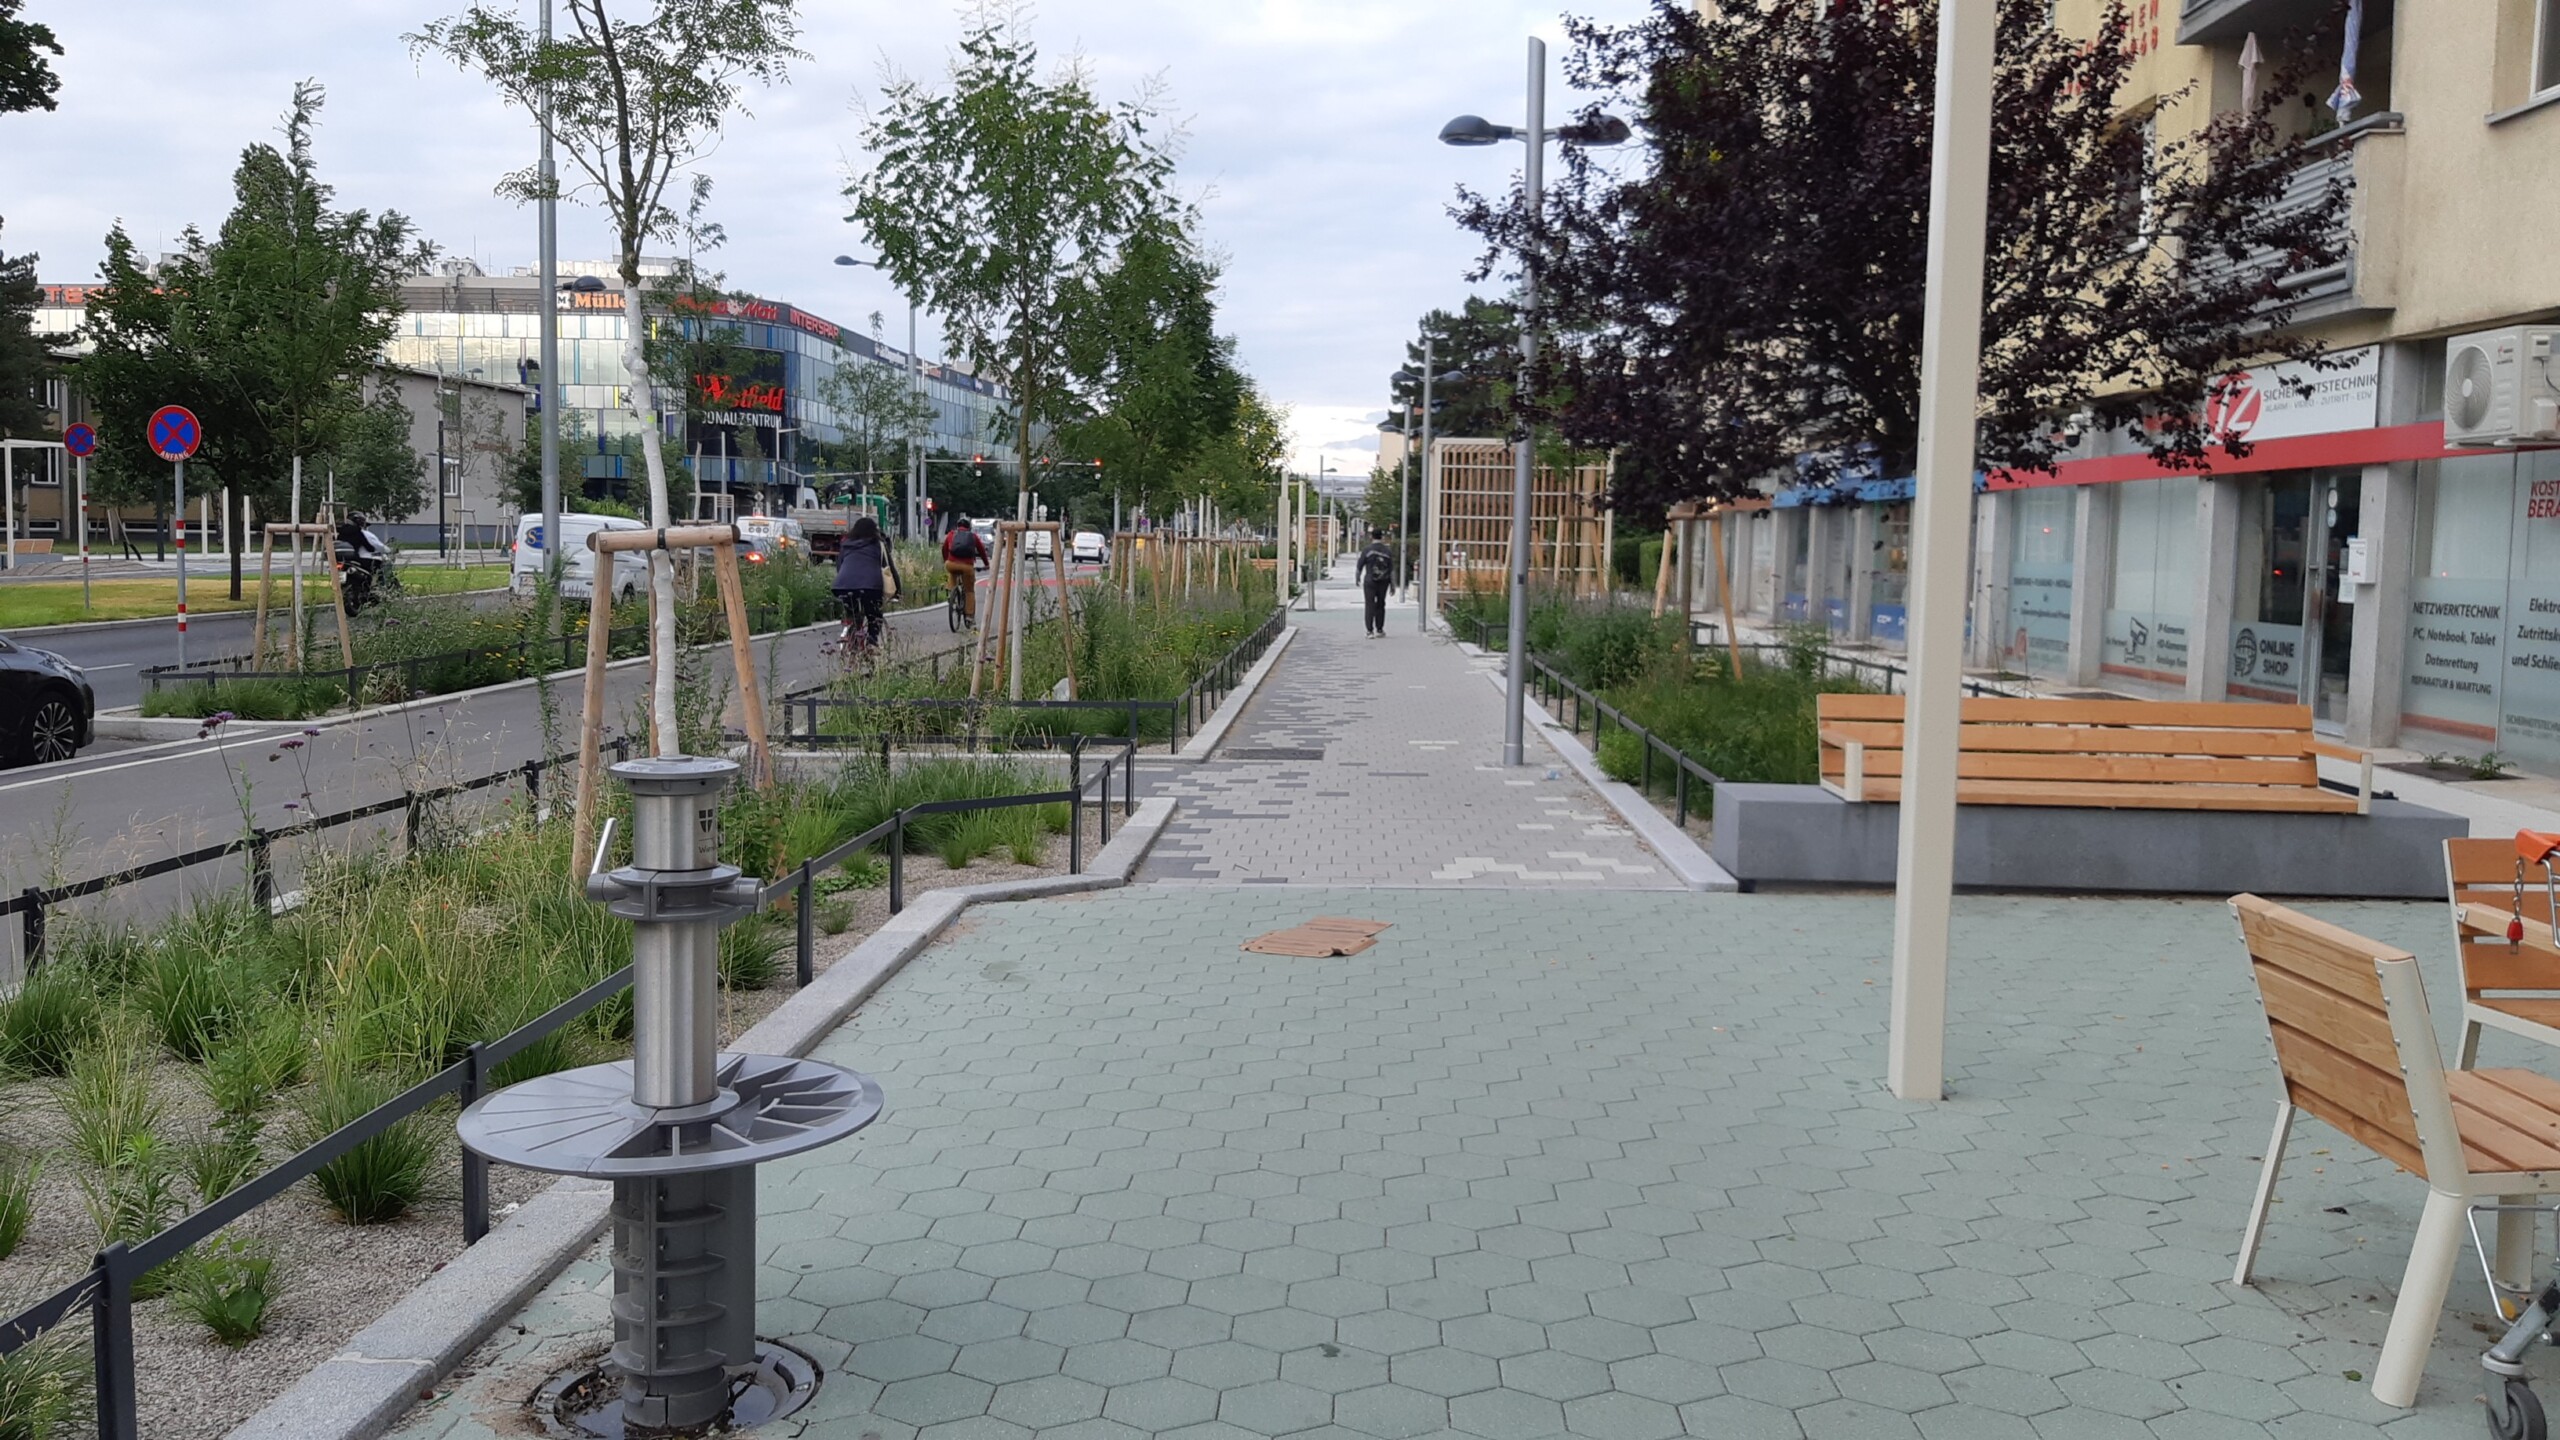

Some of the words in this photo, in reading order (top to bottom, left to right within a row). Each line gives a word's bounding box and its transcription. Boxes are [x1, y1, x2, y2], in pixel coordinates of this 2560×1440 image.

[575, 291, 626, 308] Mülle
[790, 308, 839, 339] INTERSPAR
[2263, 373, 2378, 401] SICHERITSTECHNIK
[739, 412, 782, 428] ZENTRUM
[160, 450, 190, 461] ANFANG
[2413, 601, 2500, 619] NETZWERKTECHNIK
[2470, 631, 2497, 646] Tablet
[2260, 639, 2295, 658] ONLINE
[2263, 659, 2289, 676] SHOP
[2424, 652, 2479, 673] Datenrettung
[2511, 653, 2530, 668] und
[2411, 674, 2449, 689] REPARATUR
[2455, 681, 2492, 694] WARTUNG
